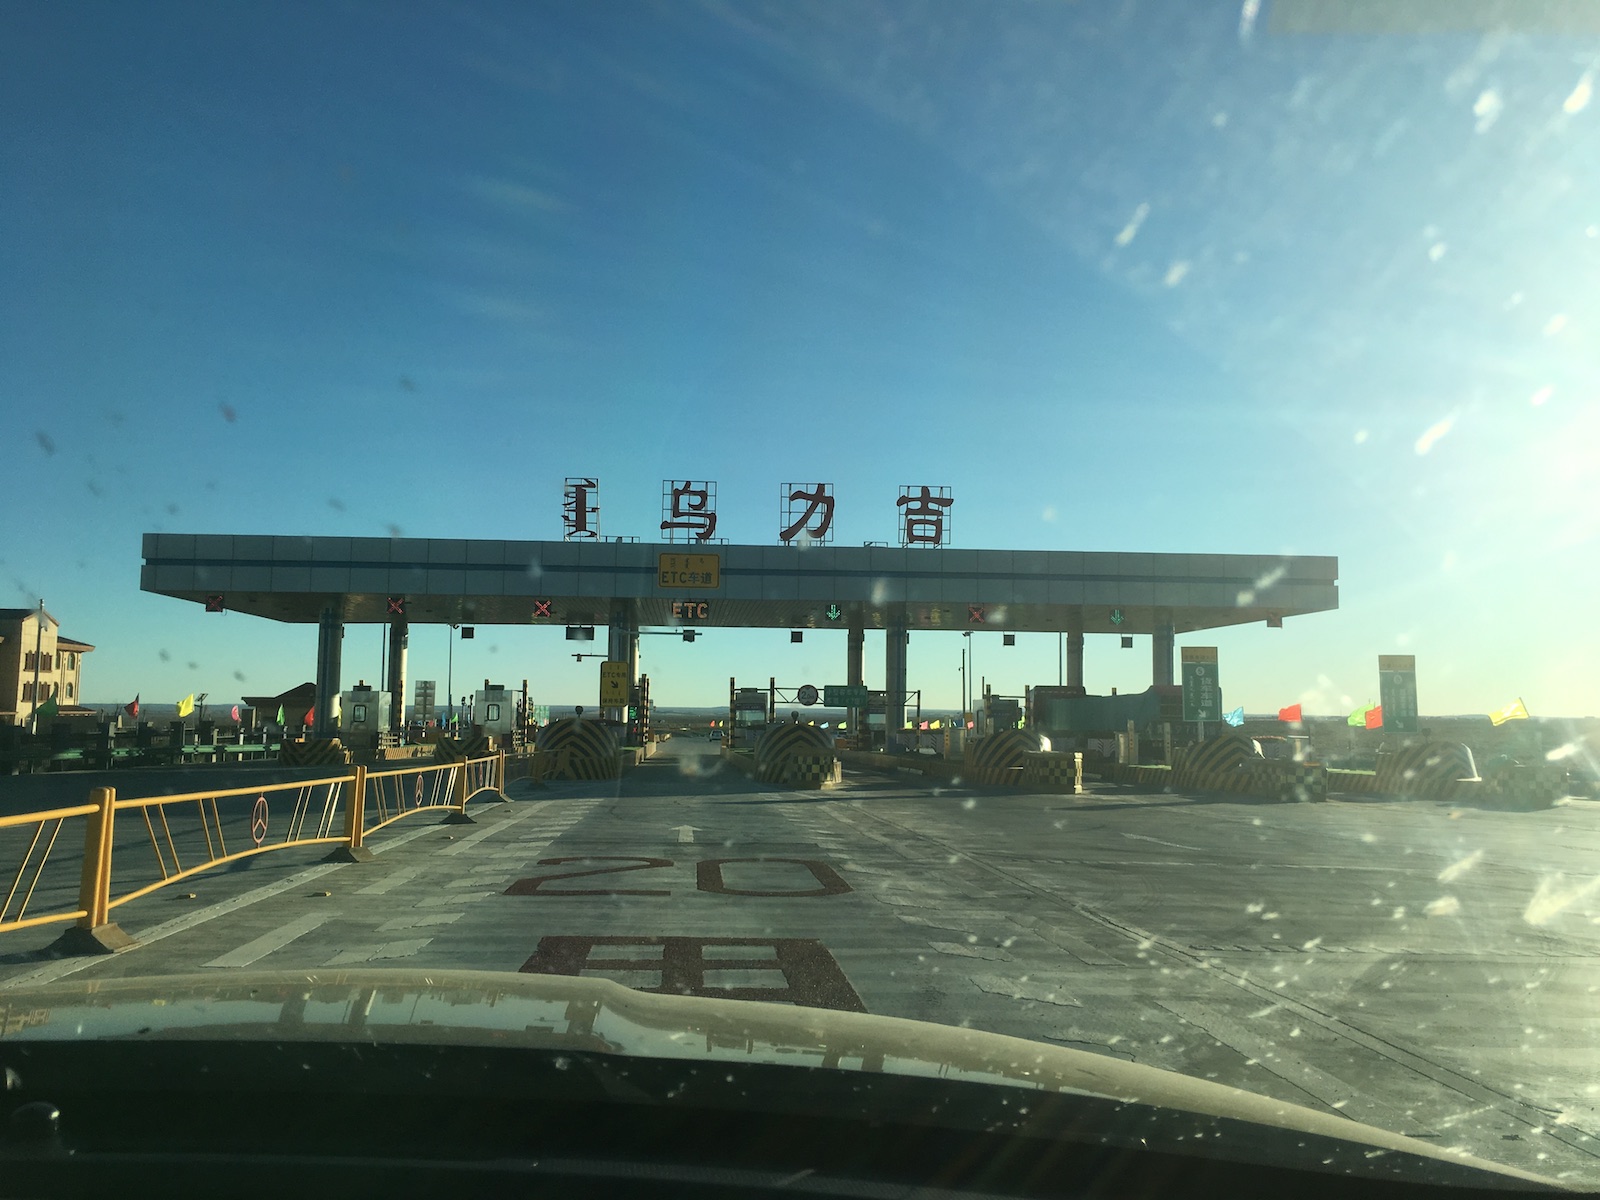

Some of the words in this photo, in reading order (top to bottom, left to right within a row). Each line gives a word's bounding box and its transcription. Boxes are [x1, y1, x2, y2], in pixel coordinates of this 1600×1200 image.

[660, 481, 954, 544] 乌力吉
[661, 571, 713, 584] ETC车道
[672, 602, 708, 619] ETC
[502, 856, 854, 897] 20
